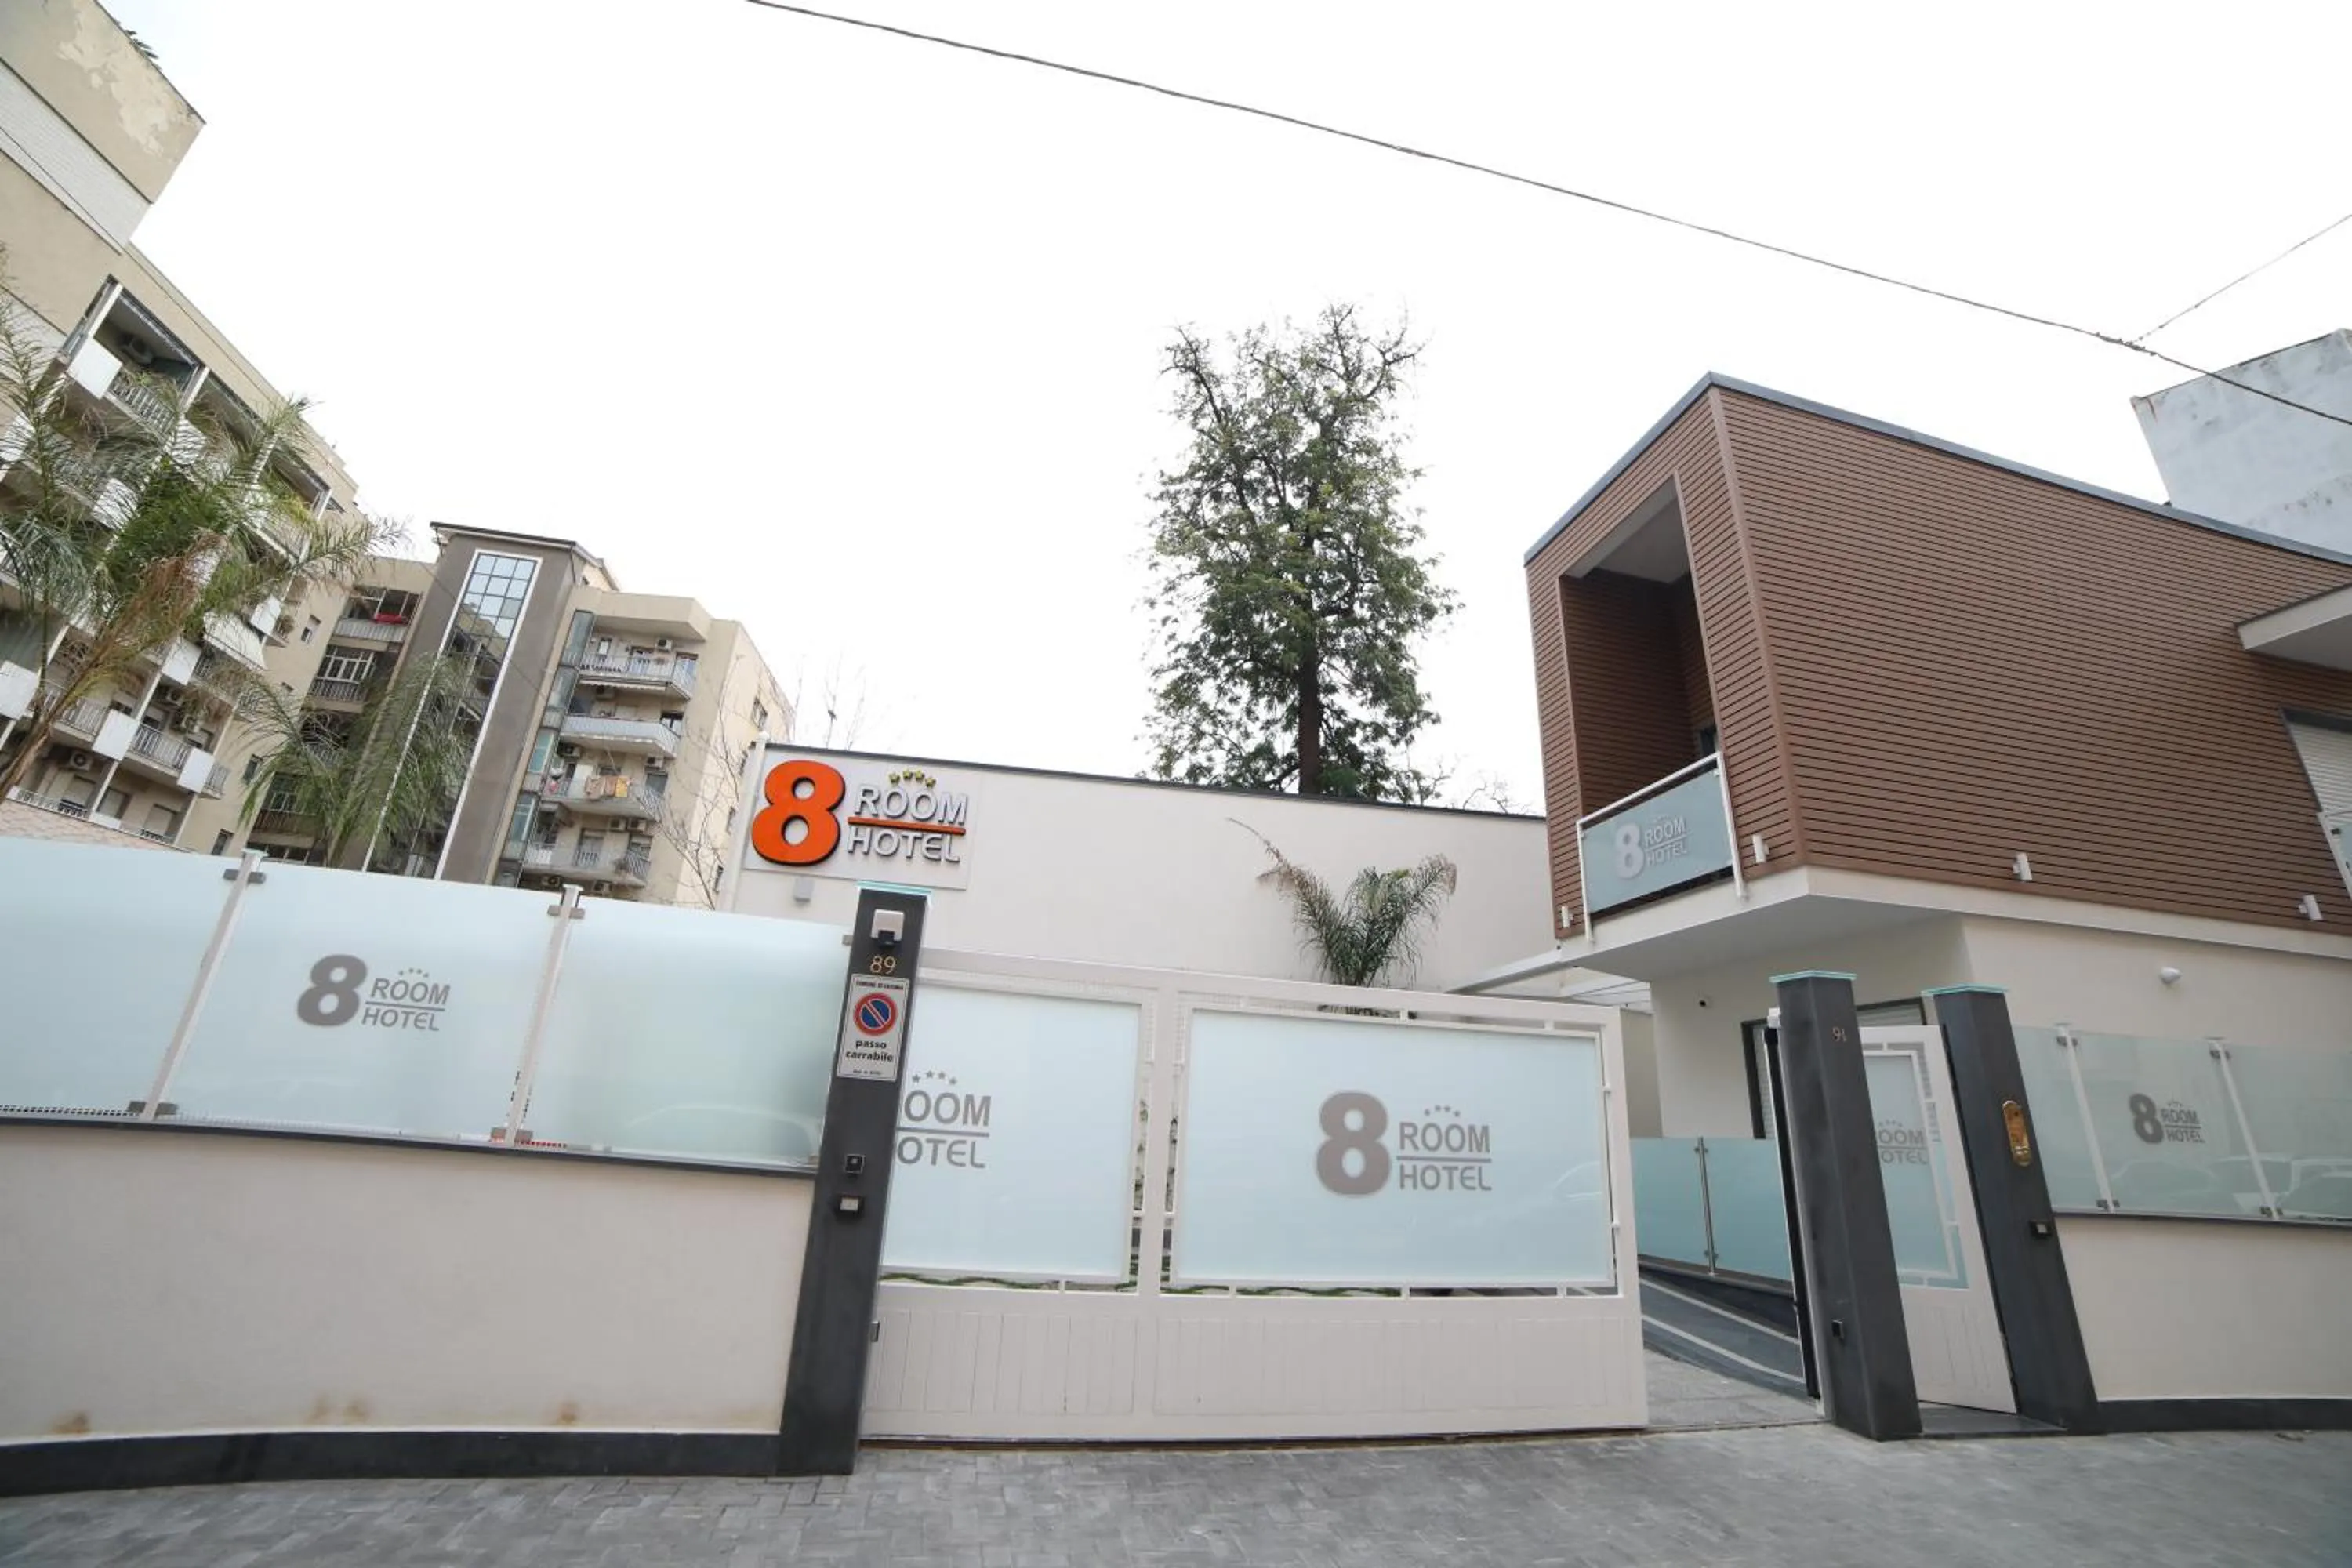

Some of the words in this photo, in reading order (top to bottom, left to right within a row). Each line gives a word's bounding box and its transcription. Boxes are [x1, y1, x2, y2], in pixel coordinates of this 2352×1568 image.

[752, 760, 845, 866] 8
[855, 784, 968, 826] ROOM
[847, 827, 961, 863] HOTEL
[1615, 823, 1644, 879] 8
[1645, 816, 1686, 847] ROOM
[1647, 841, 1687, 866] HOTEL
[870, 956, 896, 975] 89
[296, 953, 368, 1027] 8
[370, 978, 451, 1005] ROOM
[361, 1007, 440, 1032] HOTEL
[845, 1051, 893, 1062] carrabile
[856, 1040, 887, 1049] passo
[904, 1089, 992, 1127] OOM
[2129, 1093, 2164, 1145] 8
[2161, 1108, 2200, 1125] ROOM
[1316, 1091, 1392, 1196] 8
[1399, 1121, 1490, 1153] ROOM
[1878, 1129, 1926, 1145] OOM
[2165, 1128, 2205, 1143] HOTEL
[898, 1136, 986, 1168] OTEL
[1882, 1150, 1928, 1164] OTEL
[1399, 1163, 1492, 1191] HOTEL
